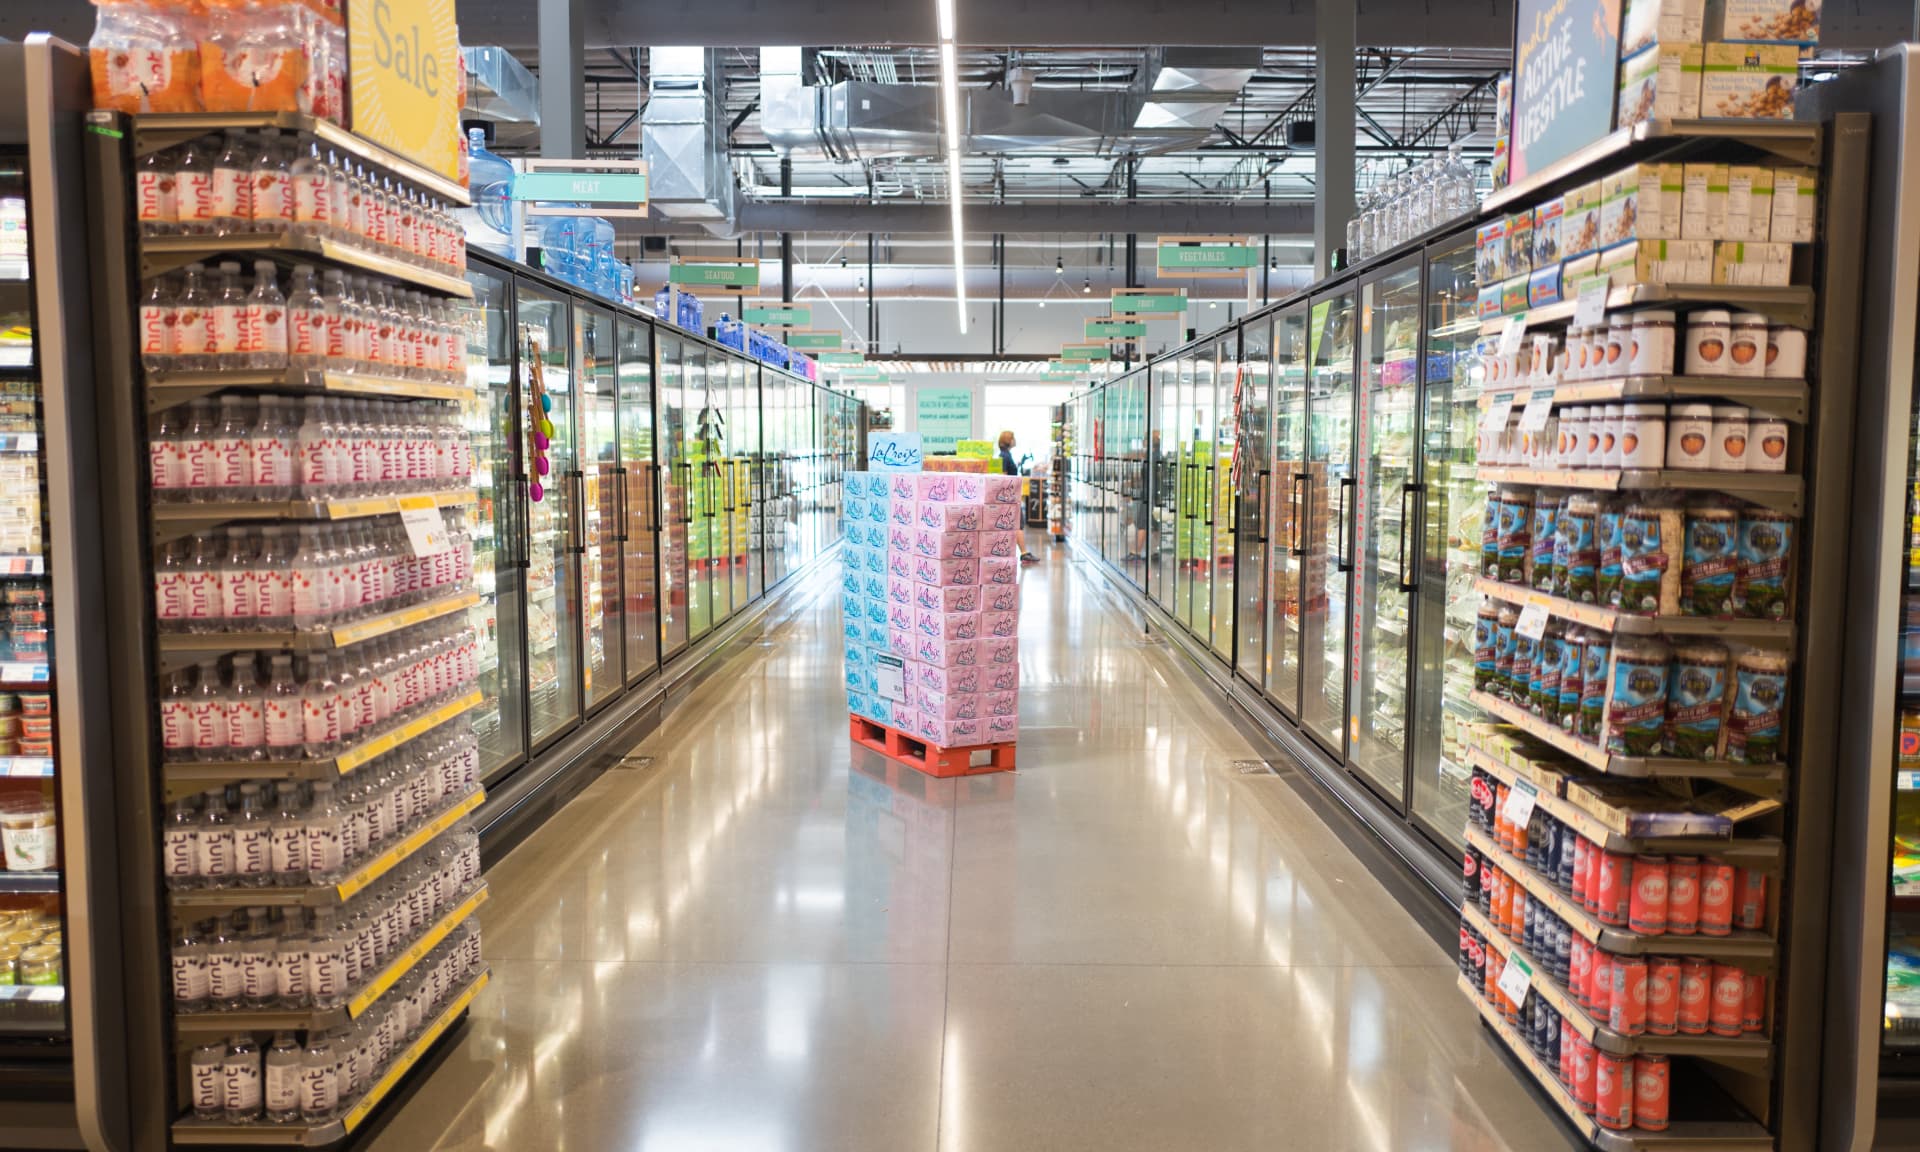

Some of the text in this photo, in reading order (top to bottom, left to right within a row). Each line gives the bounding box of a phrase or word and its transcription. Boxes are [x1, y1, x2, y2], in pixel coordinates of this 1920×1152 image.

[373, 0, 438, 97] Sale
[1523, 17, 1573, 102] ACTIVE
[1519, 57, 1586, 150] LIFESTYLE
[192, 176, 208, 218] hint
[310, 176, 326, 221] hint
[573, 181, 600, 193] MEAT
[704, 270, 735, 280] SEAFOOD
[1179, 252, 1225, 261] VEGETABLES
[144, 308, 160, 352] hint
[294, 312, 310, 352] hint
[326, 315, 343, 355] hint
[188, 444, 206, 485] hint
[224, 442, 240, 484] hint
[257, 442, 273, 484] hint
[307, 441, 323, 482] hint
[870, 442, 920, 466] LaCroix
[161, 576, 178, 616] hint
[190, 576, 206, 616] hint
[230, 575, 247, 615] hint
[258, 574, 271, 615] hint
[163, 704, 177, 746] hint
[196, 704, 212, 746] hint
[229, 704, 242, 746] hint
[323, 700, 337, 741] hint
[358, 685, 373, 725] hint
[171, 833, 188, 875] hint
[205, 834, 223, 875] hint
[243, 832, 261, 873] hint
[283, 829, 299, 871] hint
[309, 831, 322, 870] hint
[174, 960, 188, 999] hint
[209, 957, 222, 996] hint
[244, 956, 257, 996] hint
[286, 954, 302, 995] hint
[316, 955, 332, 995] hint
[197, 1067, 213, 1108] hint
[226, 1067, 240, 1108] hint
[309, 1069, 324, 1110] hint
